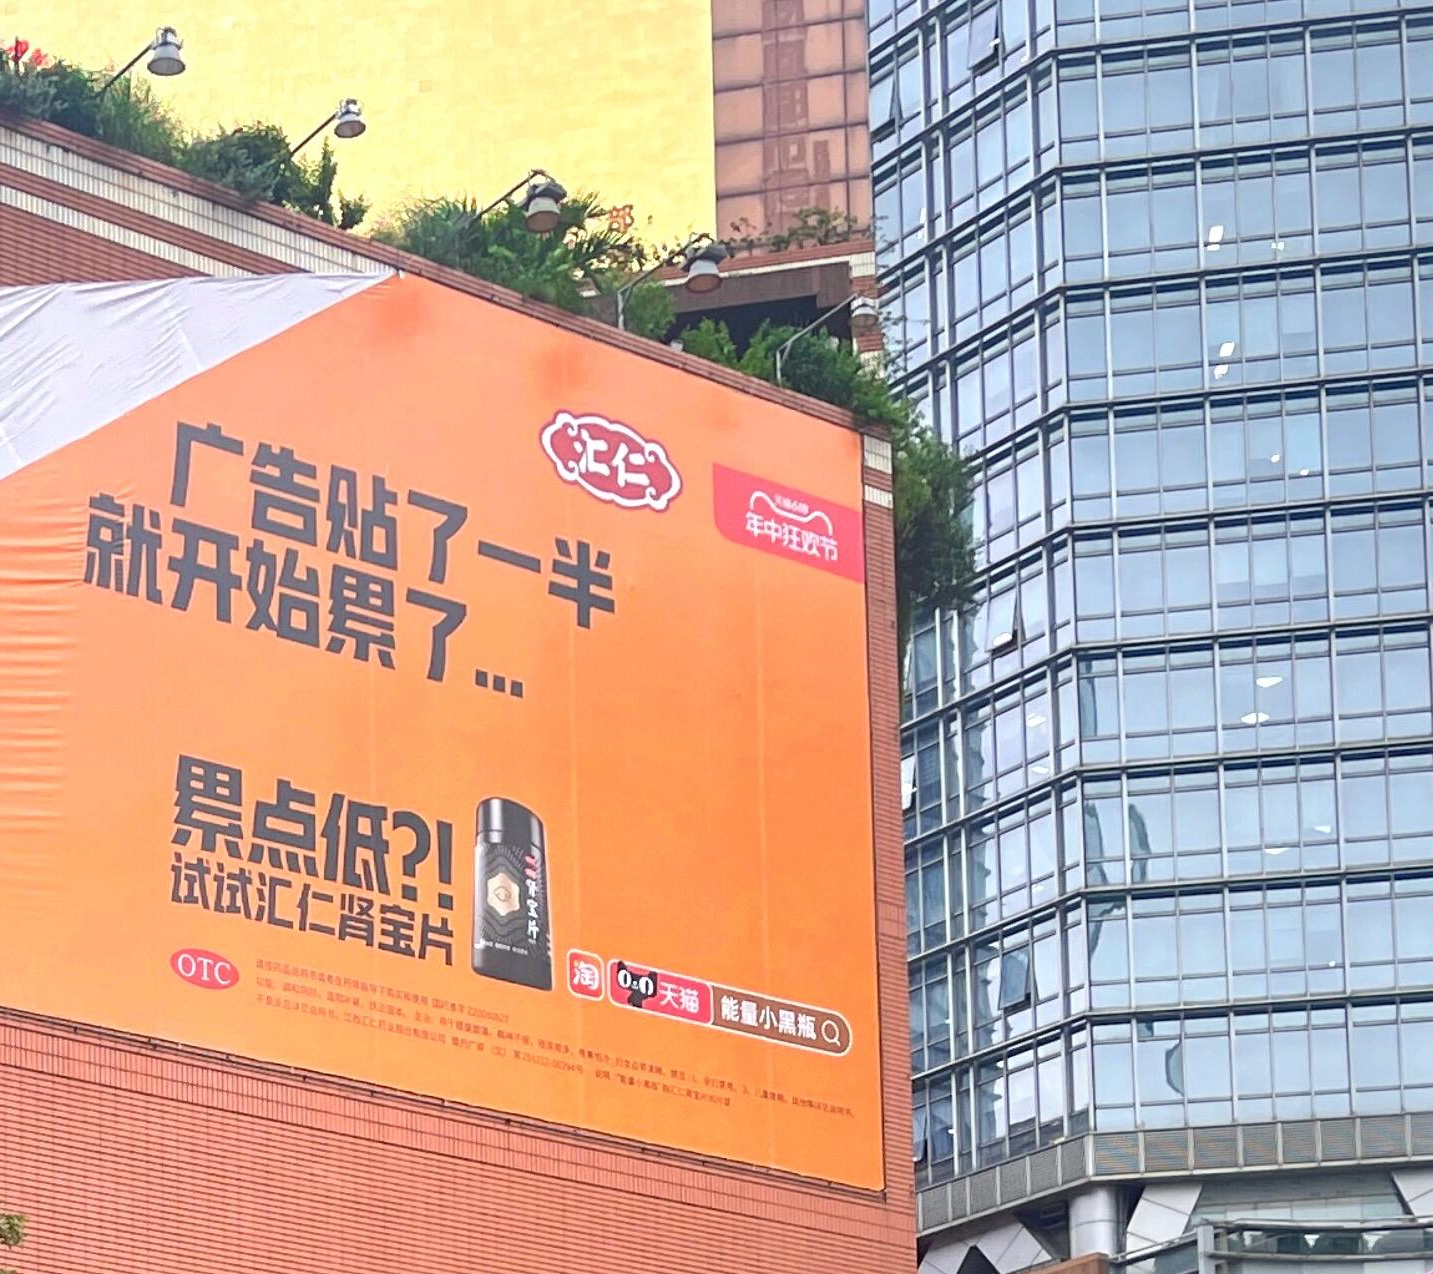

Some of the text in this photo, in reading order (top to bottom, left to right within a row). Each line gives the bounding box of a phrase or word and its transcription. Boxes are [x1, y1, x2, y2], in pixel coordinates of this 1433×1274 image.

[573, 428, 649, 488] 汇仁
[169, 420, 615, 629] 广告贴了一半
[745, 511, 838, 561] 年中狂欢节
[170, 851, 454, 967] 试试汇仁肾宝片
[177, 953, 231, 986] OTC
[573, 961, 599, 990] 淘
[659, 981, 699, 1014] 天猫
[720, 995, 817, 1041] 能量小黑瓶
